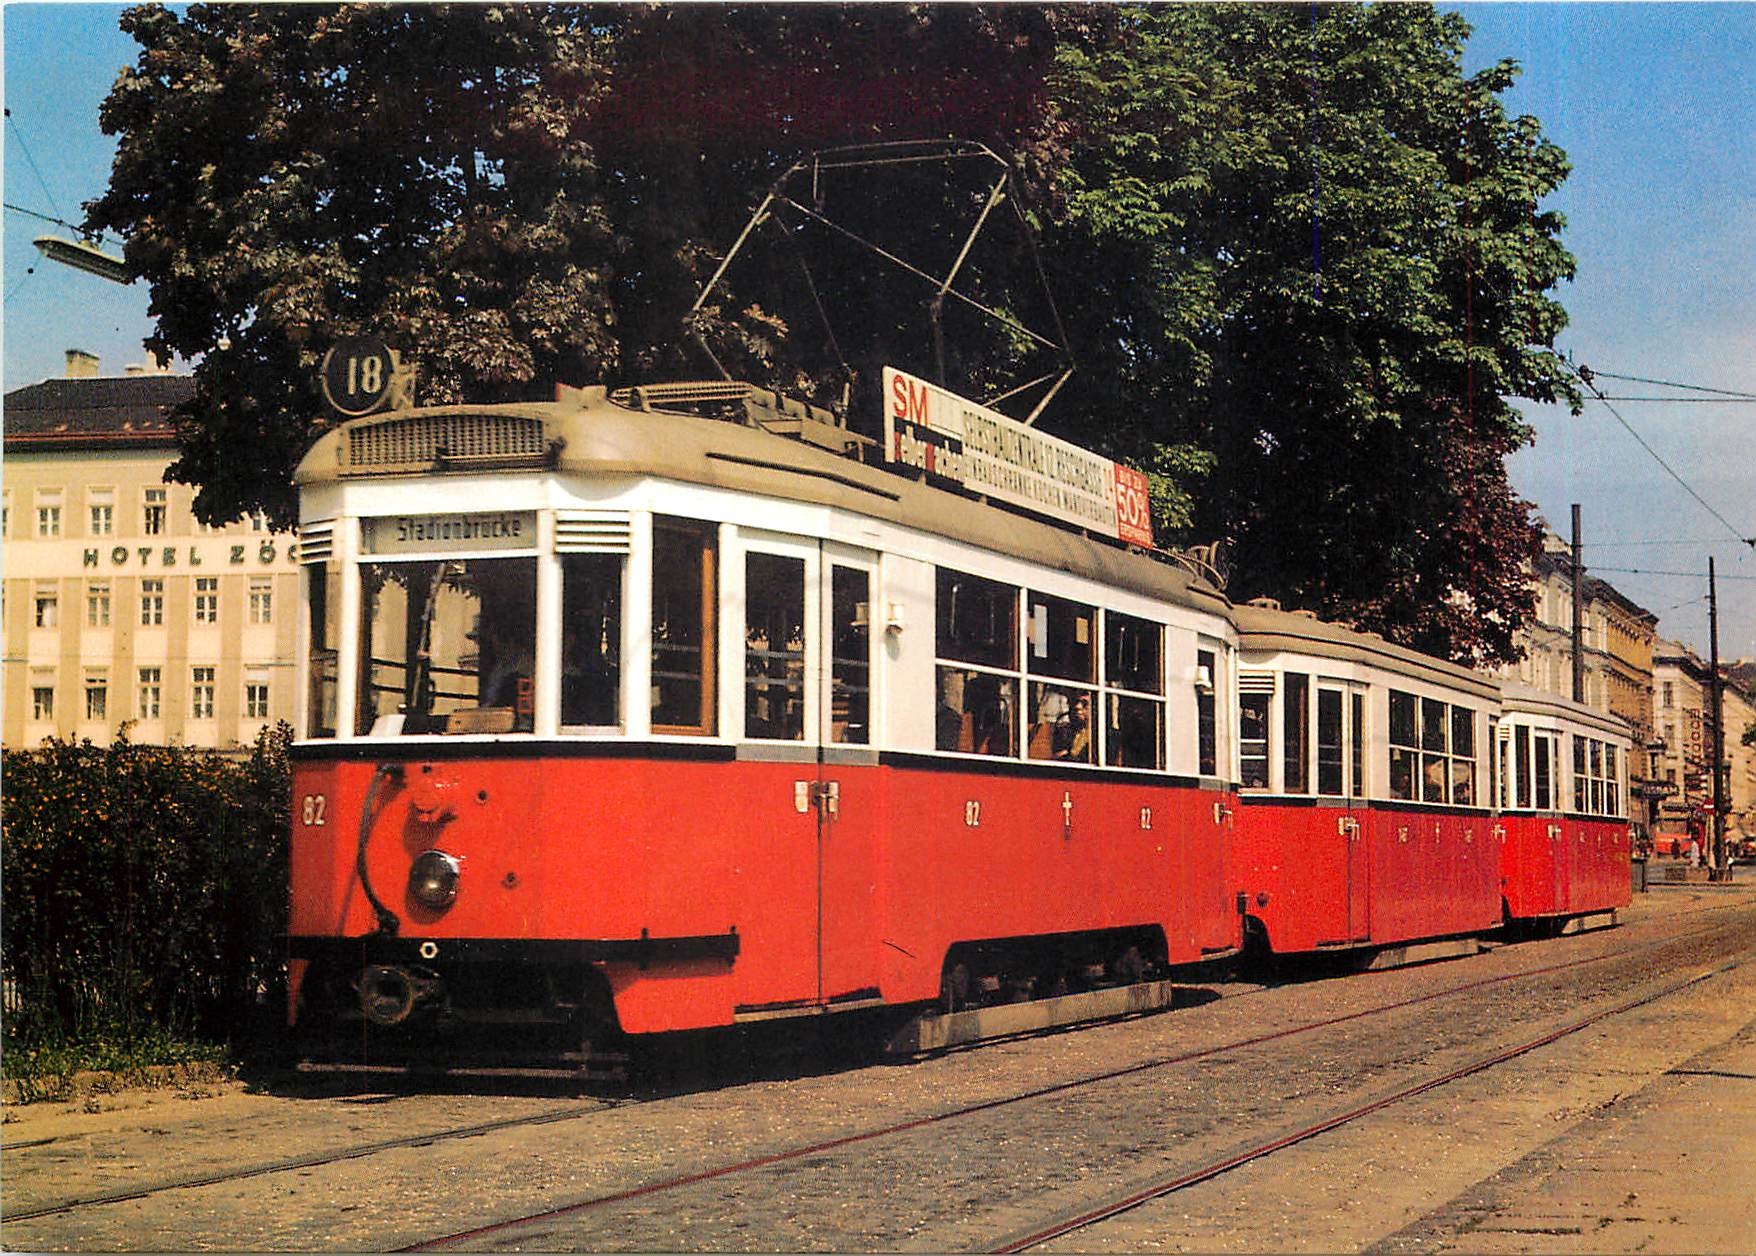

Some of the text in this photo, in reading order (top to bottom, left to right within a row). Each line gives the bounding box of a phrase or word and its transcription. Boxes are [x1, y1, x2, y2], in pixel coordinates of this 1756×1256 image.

[348, 357, 382, 395] 18
[892, 374, 929, 427] SM
[1116, 483, 1150, 531] 50%
[83, 546, 201, 568] HOTEL
[303, 795, 325, 825] 82
[965, 800, 980, 826] 82
[1140, 808, 1151, 829] 82
